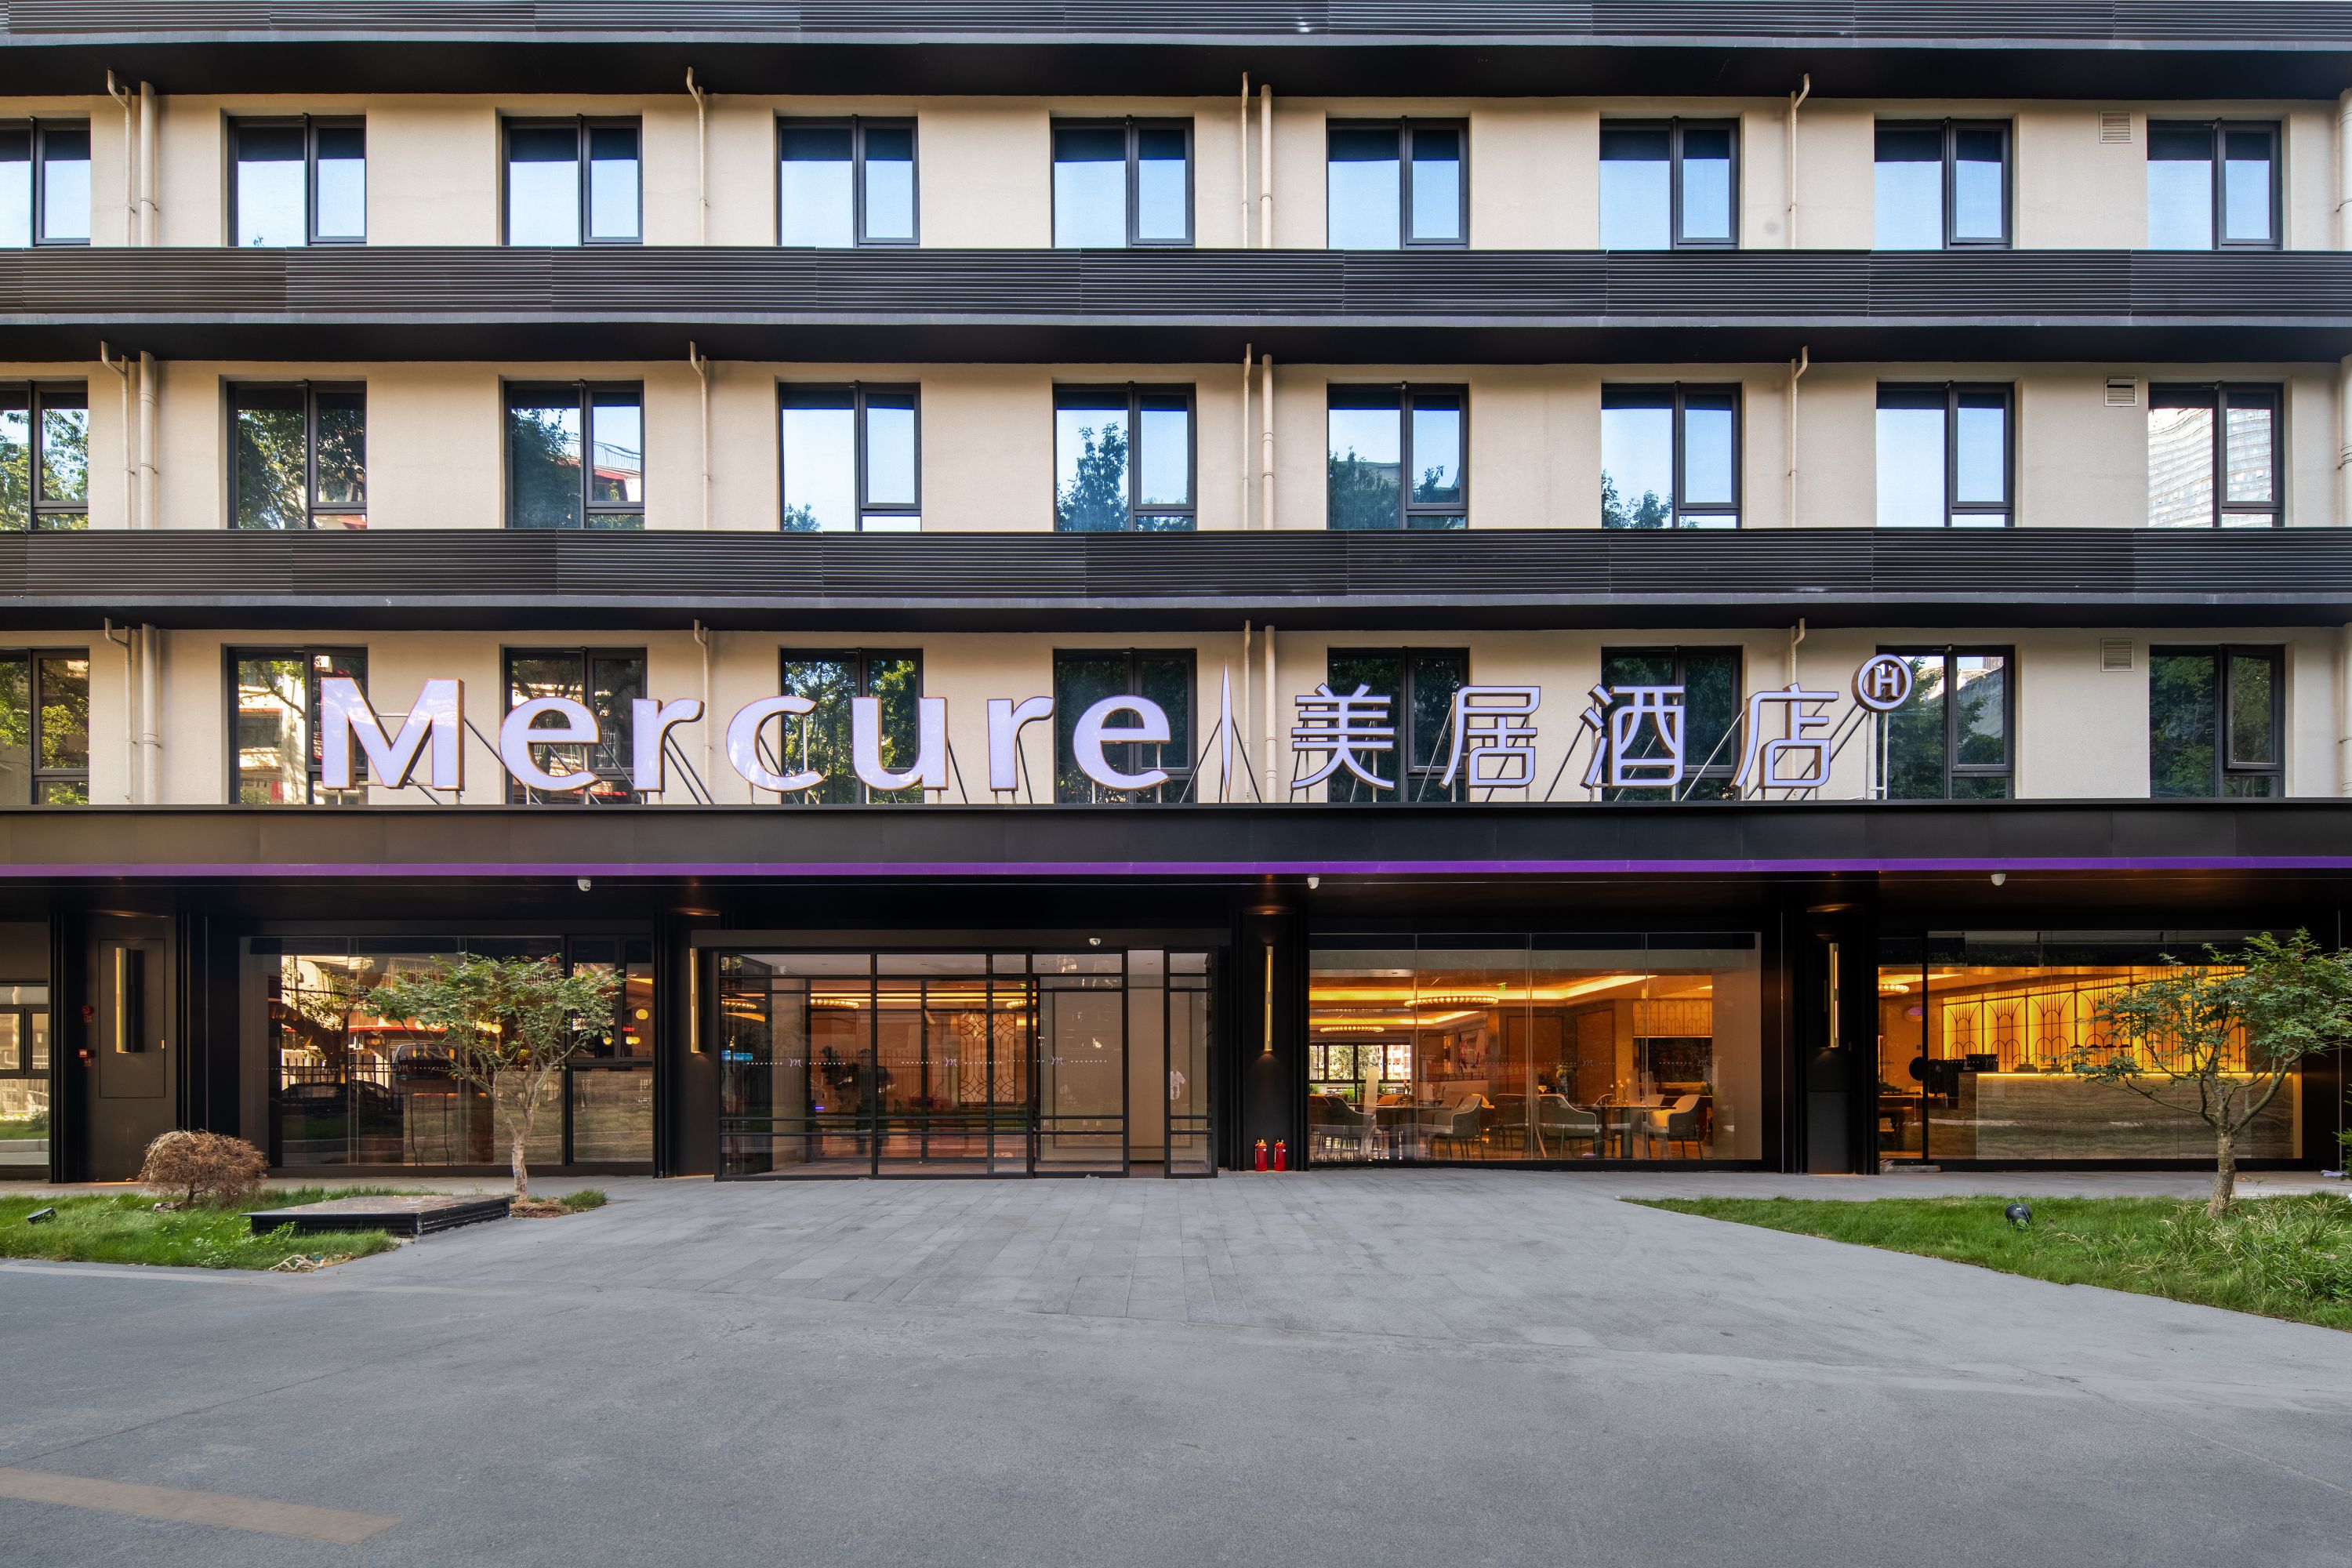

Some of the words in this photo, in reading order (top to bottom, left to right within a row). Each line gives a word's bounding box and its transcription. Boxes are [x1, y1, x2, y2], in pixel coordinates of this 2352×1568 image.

[321, 677, 1171, 792] Mercure
[1291, 682, 1839, 789] 美居酒店
